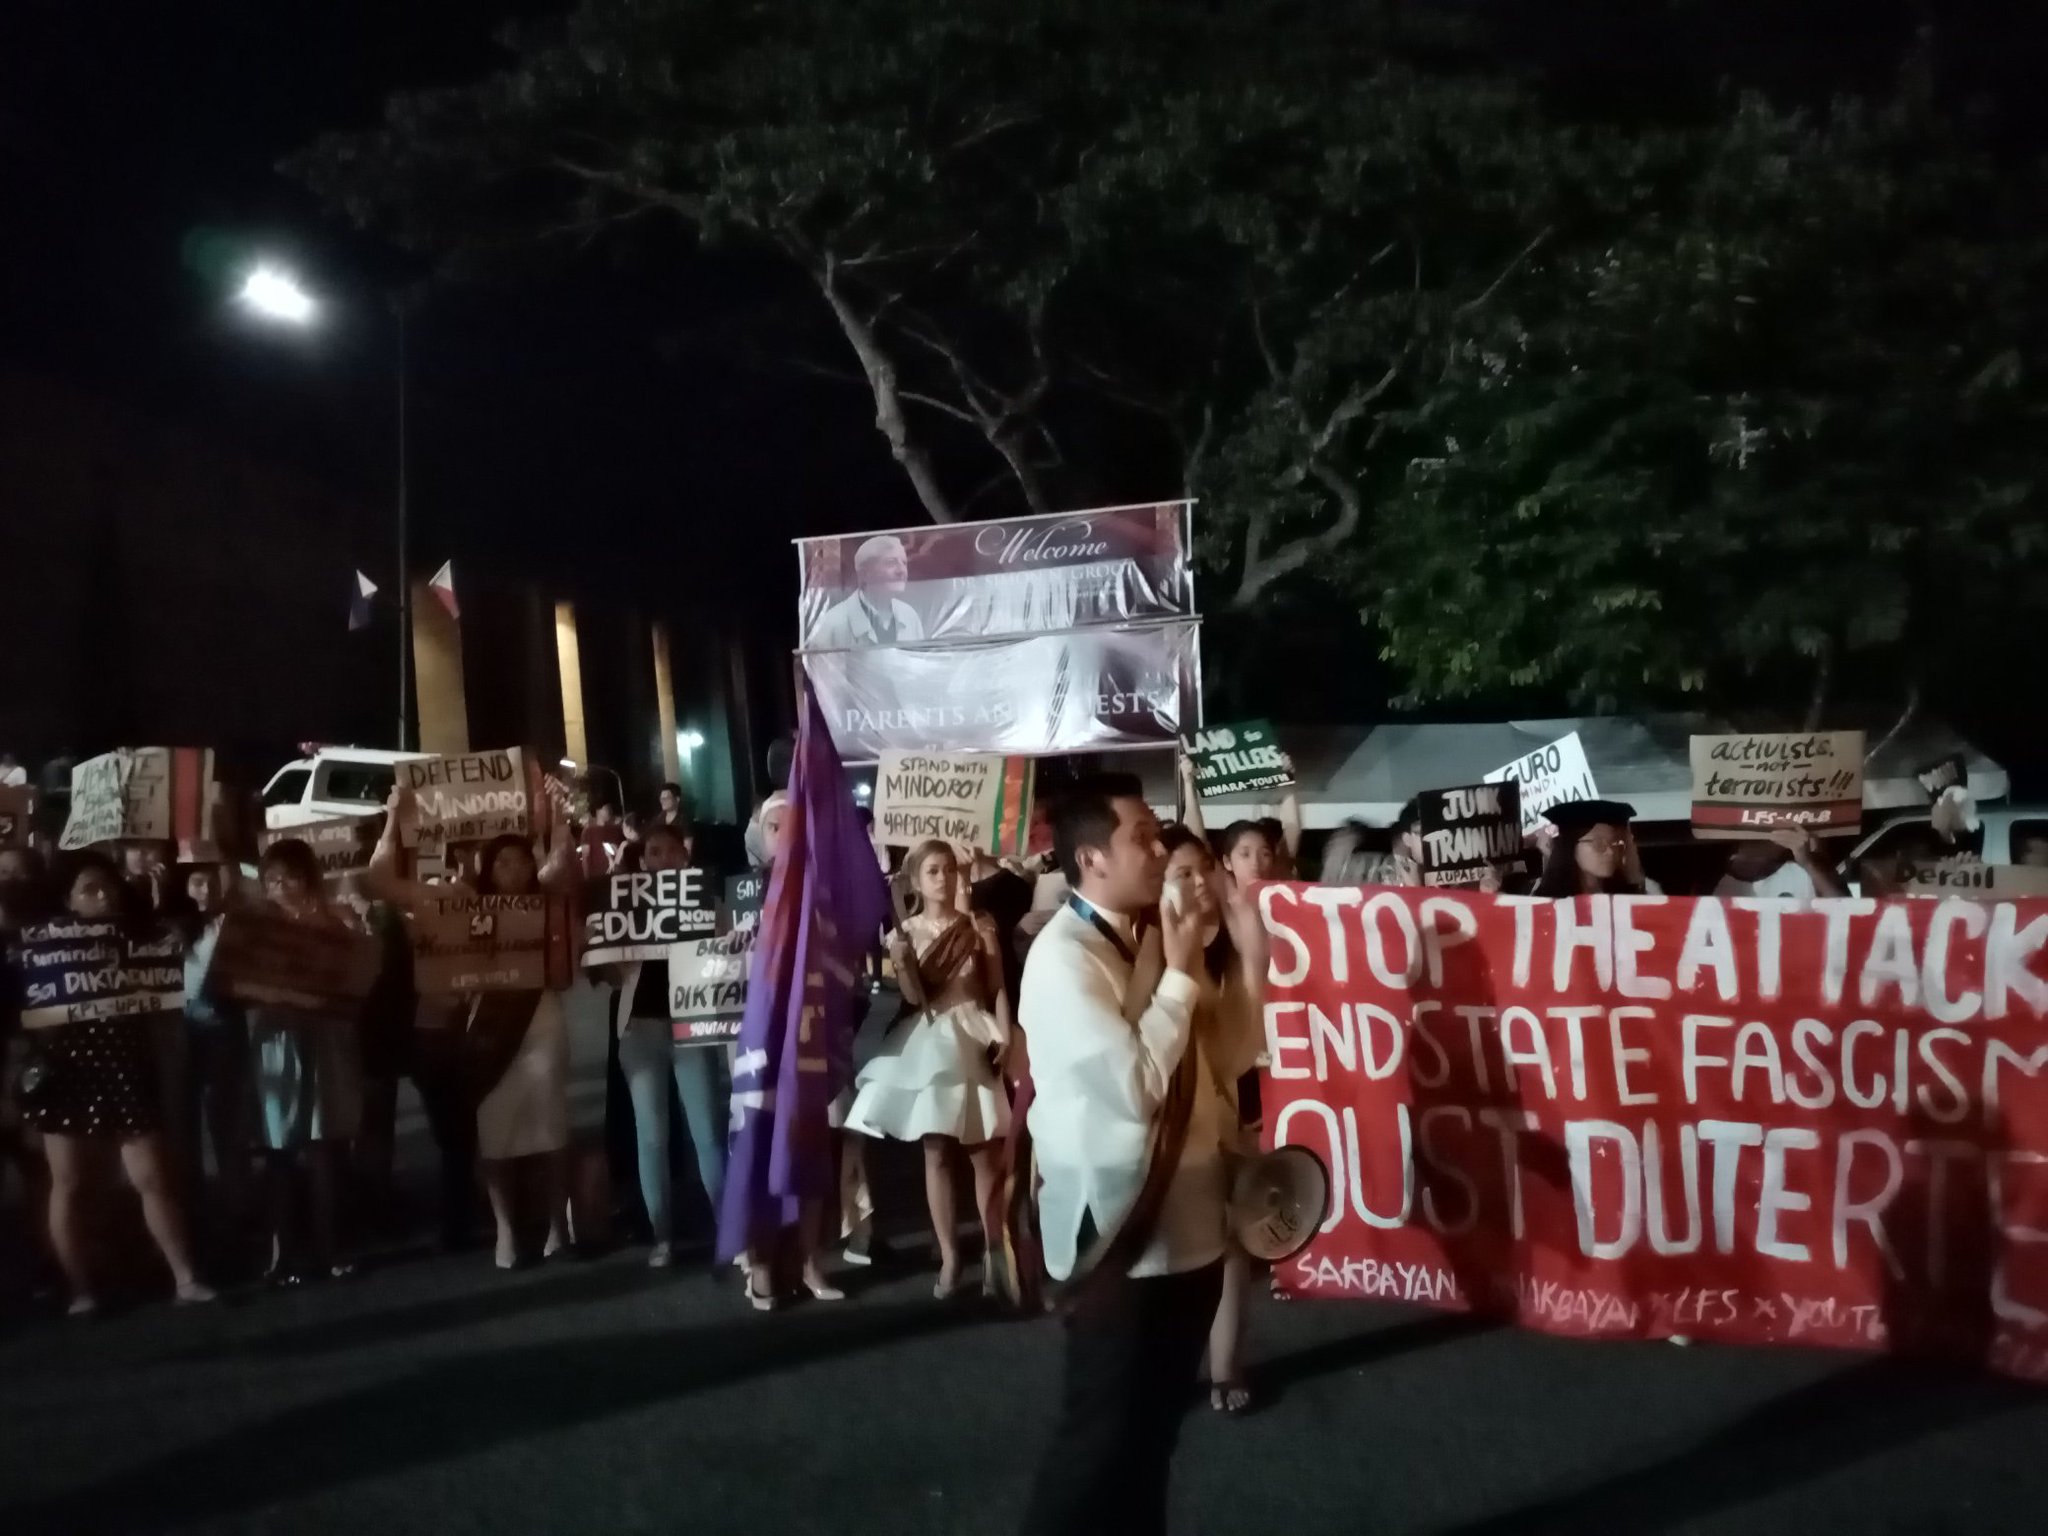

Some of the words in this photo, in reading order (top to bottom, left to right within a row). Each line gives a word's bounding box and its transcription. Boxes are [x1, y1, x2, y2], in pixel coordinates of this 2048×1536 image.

[975, 520, 1108, 564] Welcome
[409, 755, 513, 789] DEFEND
[900, 757, 950, 772] STAND
[954, 762, 988, 775] WITH
[1705, 769, 1854, 798] terrorists!!!
[886, 774, 984, 799] MINDORO!
[610, 867, 704, 909] FREE
[586, 908, 678, 946] EDUC
[679, 909, 716, 924] NOW
[1258, 884, 1478, 989] STOP
[1494, 893, 1673, 1000] THE
[1677, 896, 2048, 1023] ATTACK
[1263, 1002, 1404, 1082] END
[1411, 1000, 1659, 1107] STATE
[1274, 1098, 1541, 1241] OUST
[1564, 1117, 2048, 1329] DUTERTE
